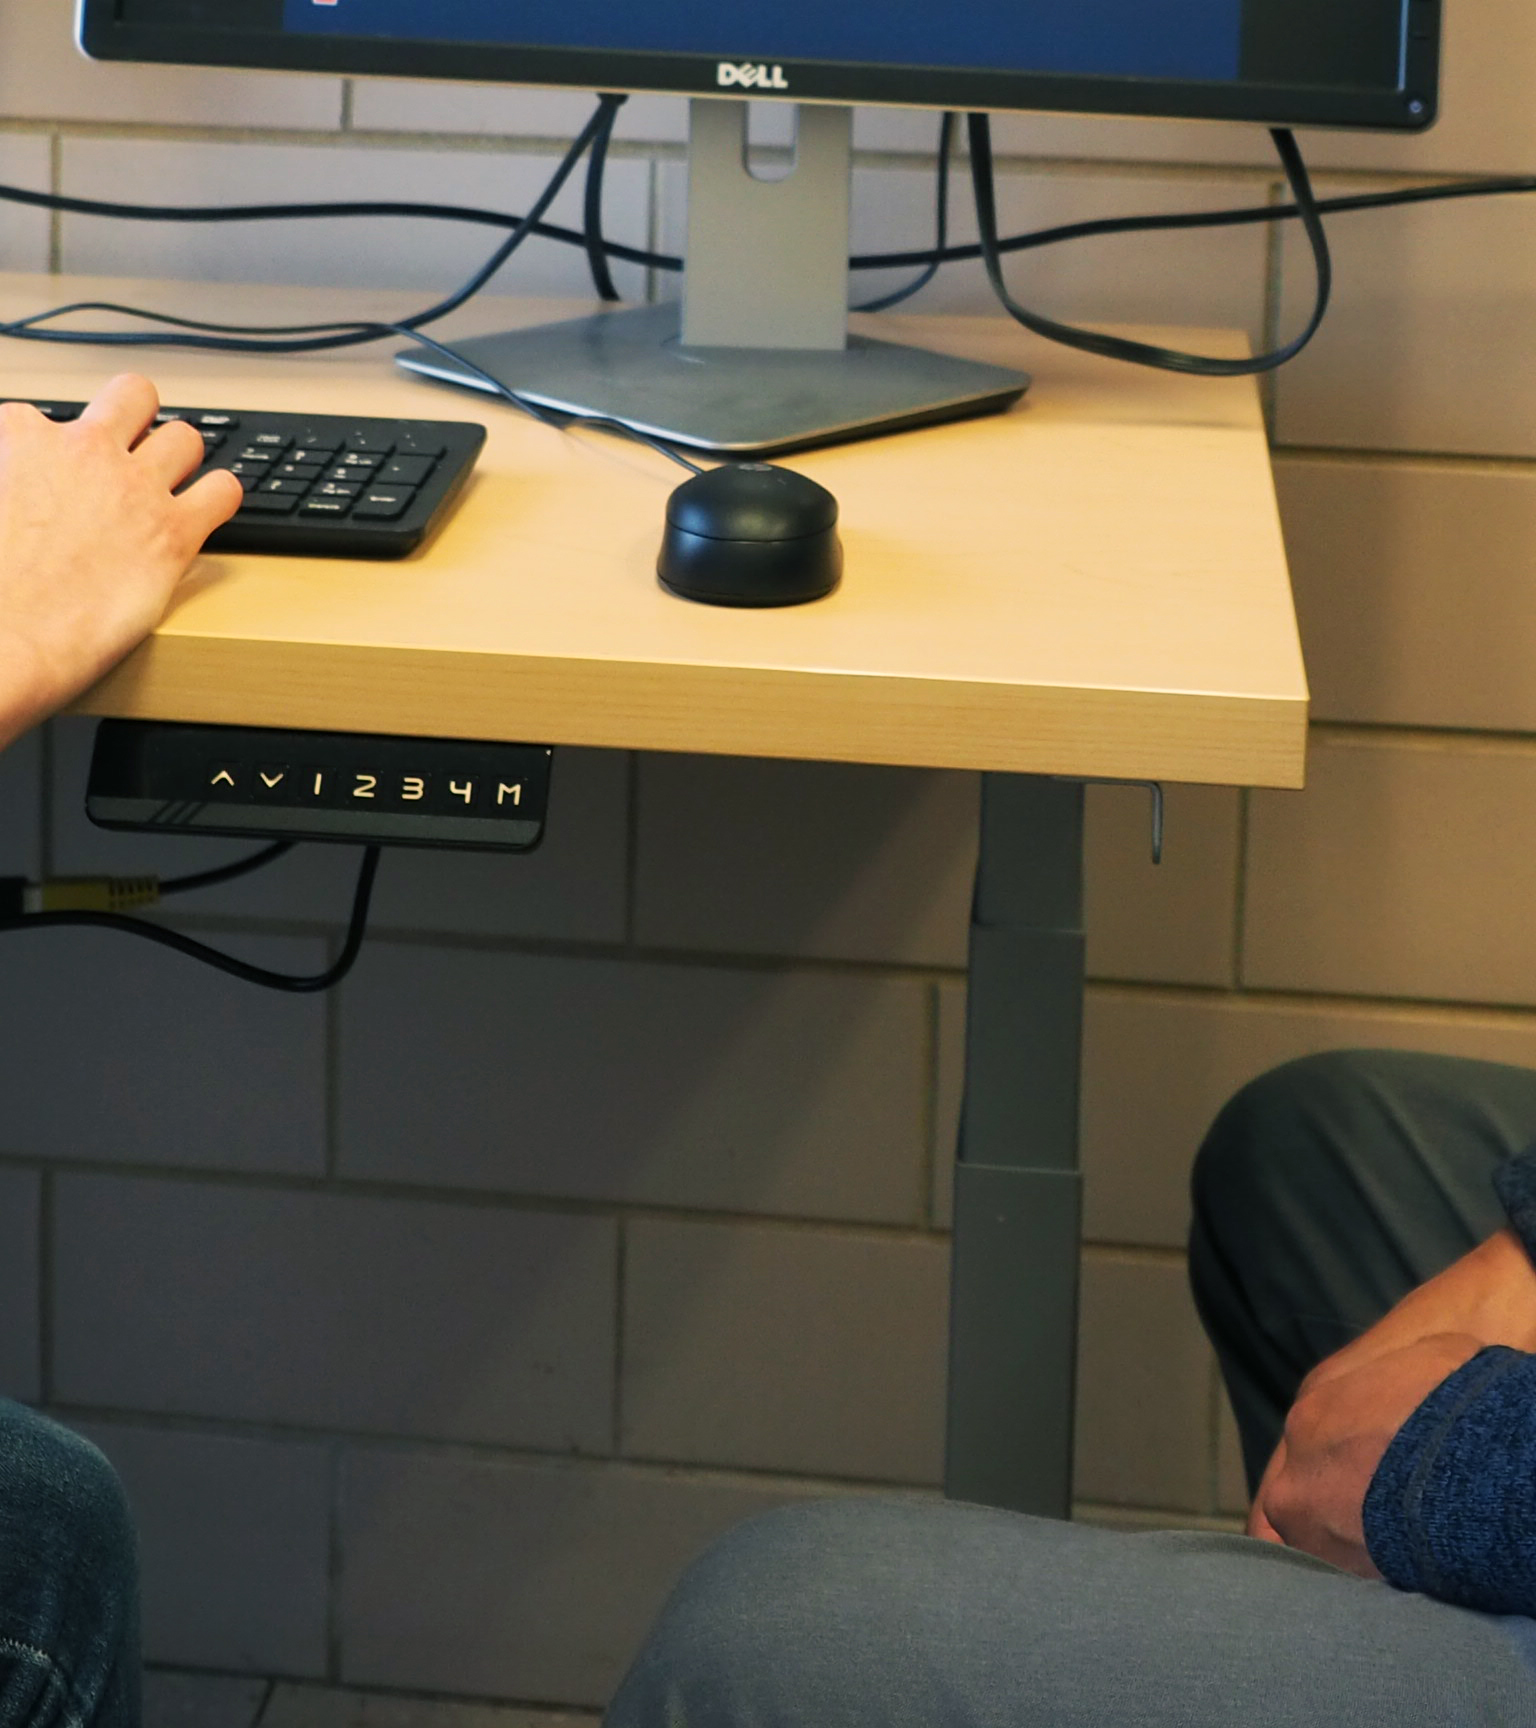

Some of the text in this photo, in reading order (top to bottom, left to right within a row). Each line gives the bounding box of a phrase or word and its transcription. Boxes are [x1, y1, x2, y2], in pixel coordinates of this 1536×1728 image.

[718, 63, 787, 88] DELL
[314, 773, 521, 806] 1 2 3 4 M
